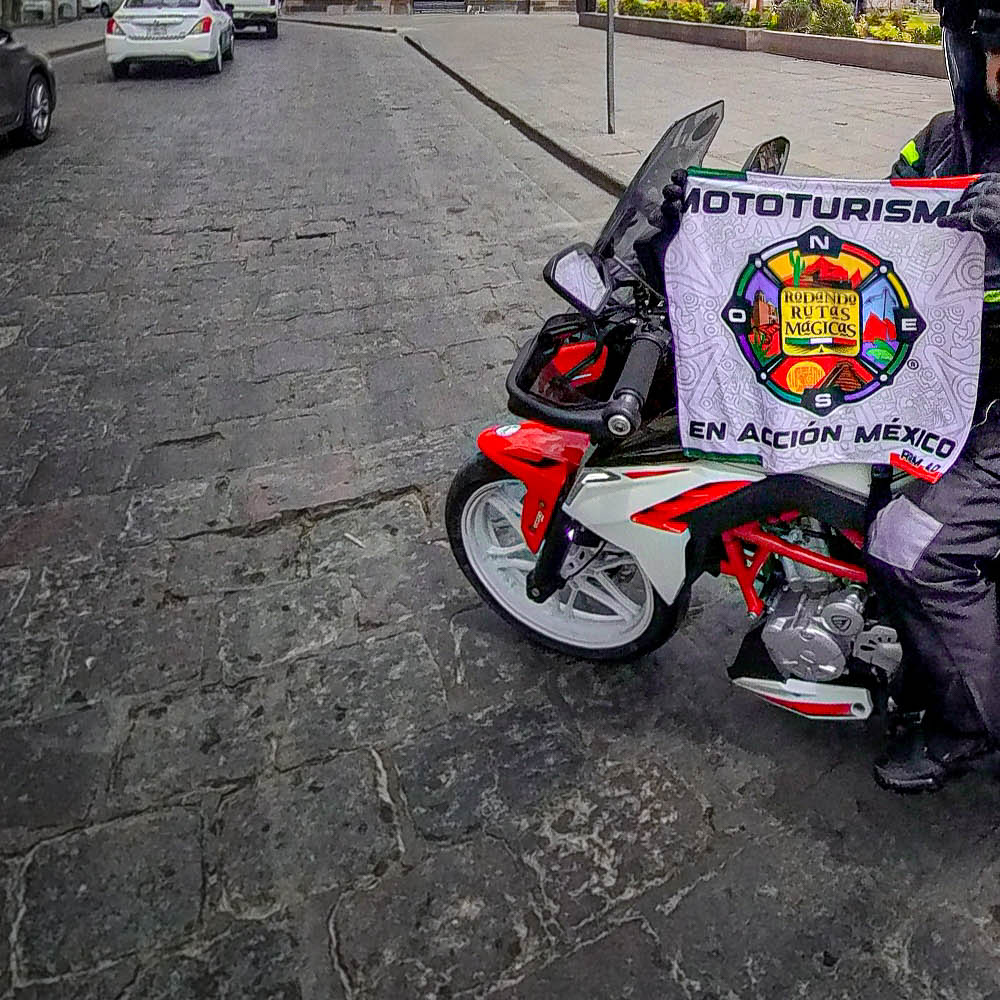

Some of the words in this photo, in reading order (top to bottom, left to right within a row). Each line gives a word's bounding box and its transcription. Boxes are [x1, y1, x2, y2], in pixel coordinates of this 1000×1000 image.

[681, 188, 959, 223] MOTOTURISM
[809, 235, 830, 250] N
[901, 319, 918, 332] E
[815, 393, 832, 408] S
[689, 420, 726, 441] EN
[737, 421, 843, 449] ACCIÓN
[854, 418, 956, 459] MÉXICO
